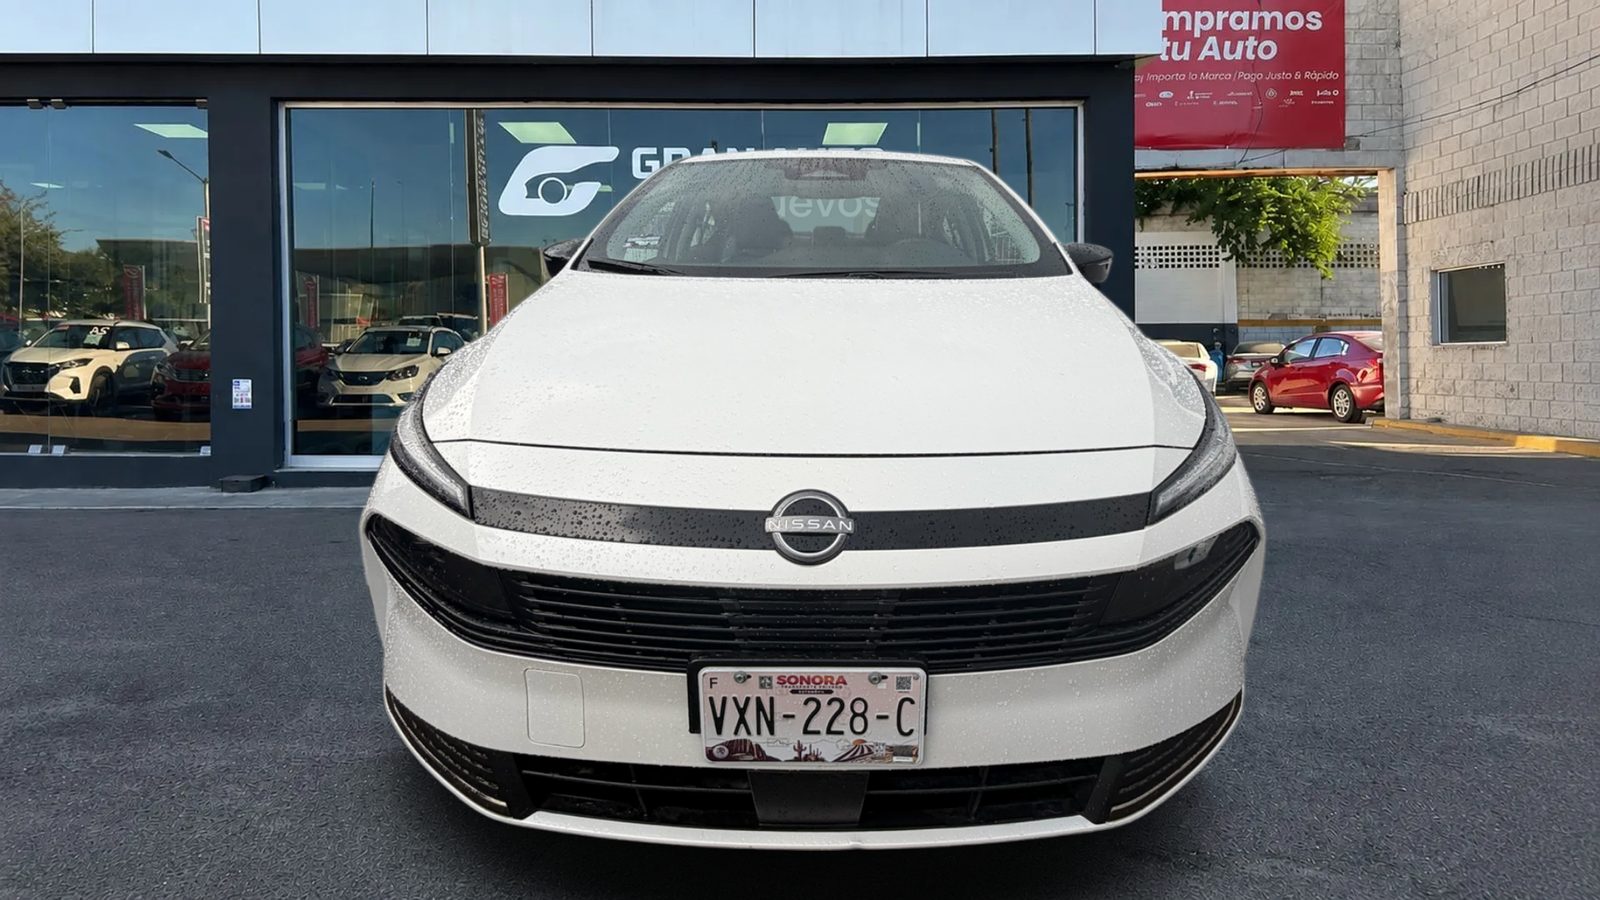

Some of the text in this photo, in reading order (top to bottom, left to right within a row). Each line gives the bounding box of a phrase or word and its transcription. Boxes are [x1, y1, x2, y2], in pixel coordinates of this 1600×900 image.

[1160, 36, 1278, 61] tu Auto
[1146, 72, 1186, 83] Importa
[1188, 72, 1198, 81] la
[1199, 72, 1232, 80] Marca
[1265, 71, 1292, 80] Justo
[1294, 71, 1301, 80] &
[768, 519, 852, 531] NISSAN
[709, 675, 848, 689] F SONORA
[708, 696, 916, 736] VXN-228-C
